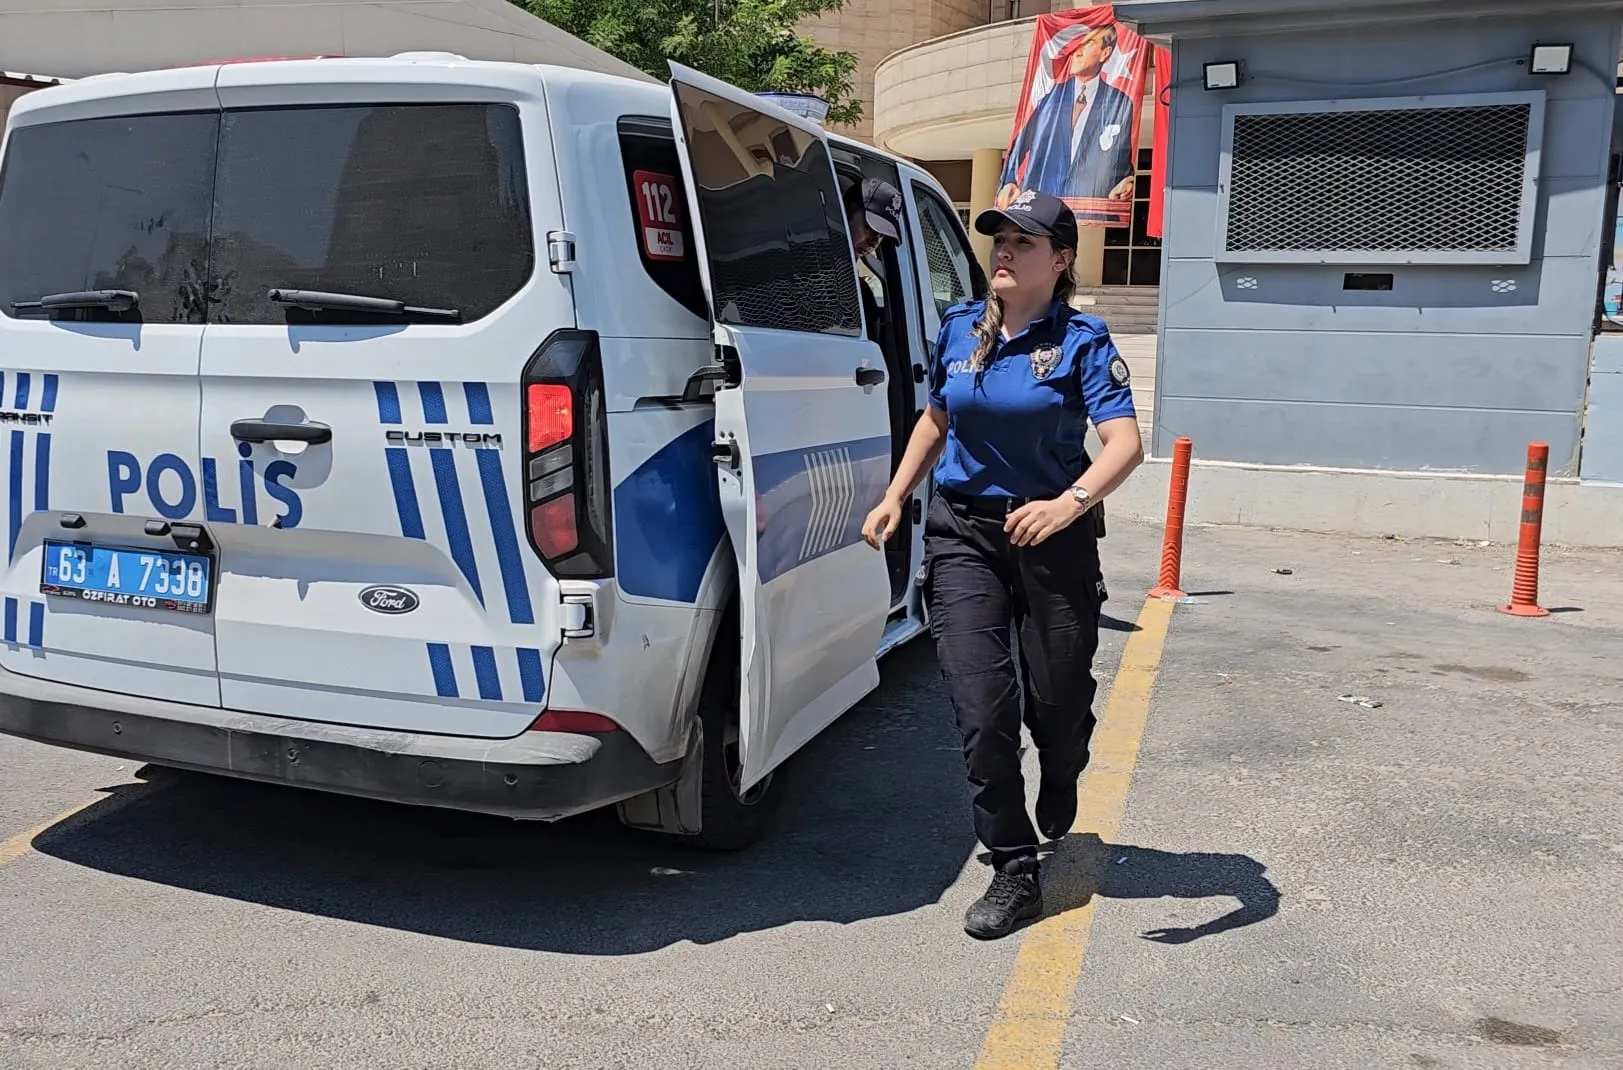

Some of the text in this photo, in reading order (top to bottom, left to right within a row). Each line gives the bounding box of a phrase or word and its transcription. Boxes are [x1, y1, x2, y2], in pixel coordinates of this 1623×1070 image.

[642, 181, 676, 223] 112
[386, 430, 502, 443] CUSTOM
[107, 442, 302, 529] POLİS
[48, 566, 58, 577] TR
[58, 547, 203, 597] 63 A 7338
[132, 595, 157, 608] OTO
[370, 590, 407, 609] Ford
